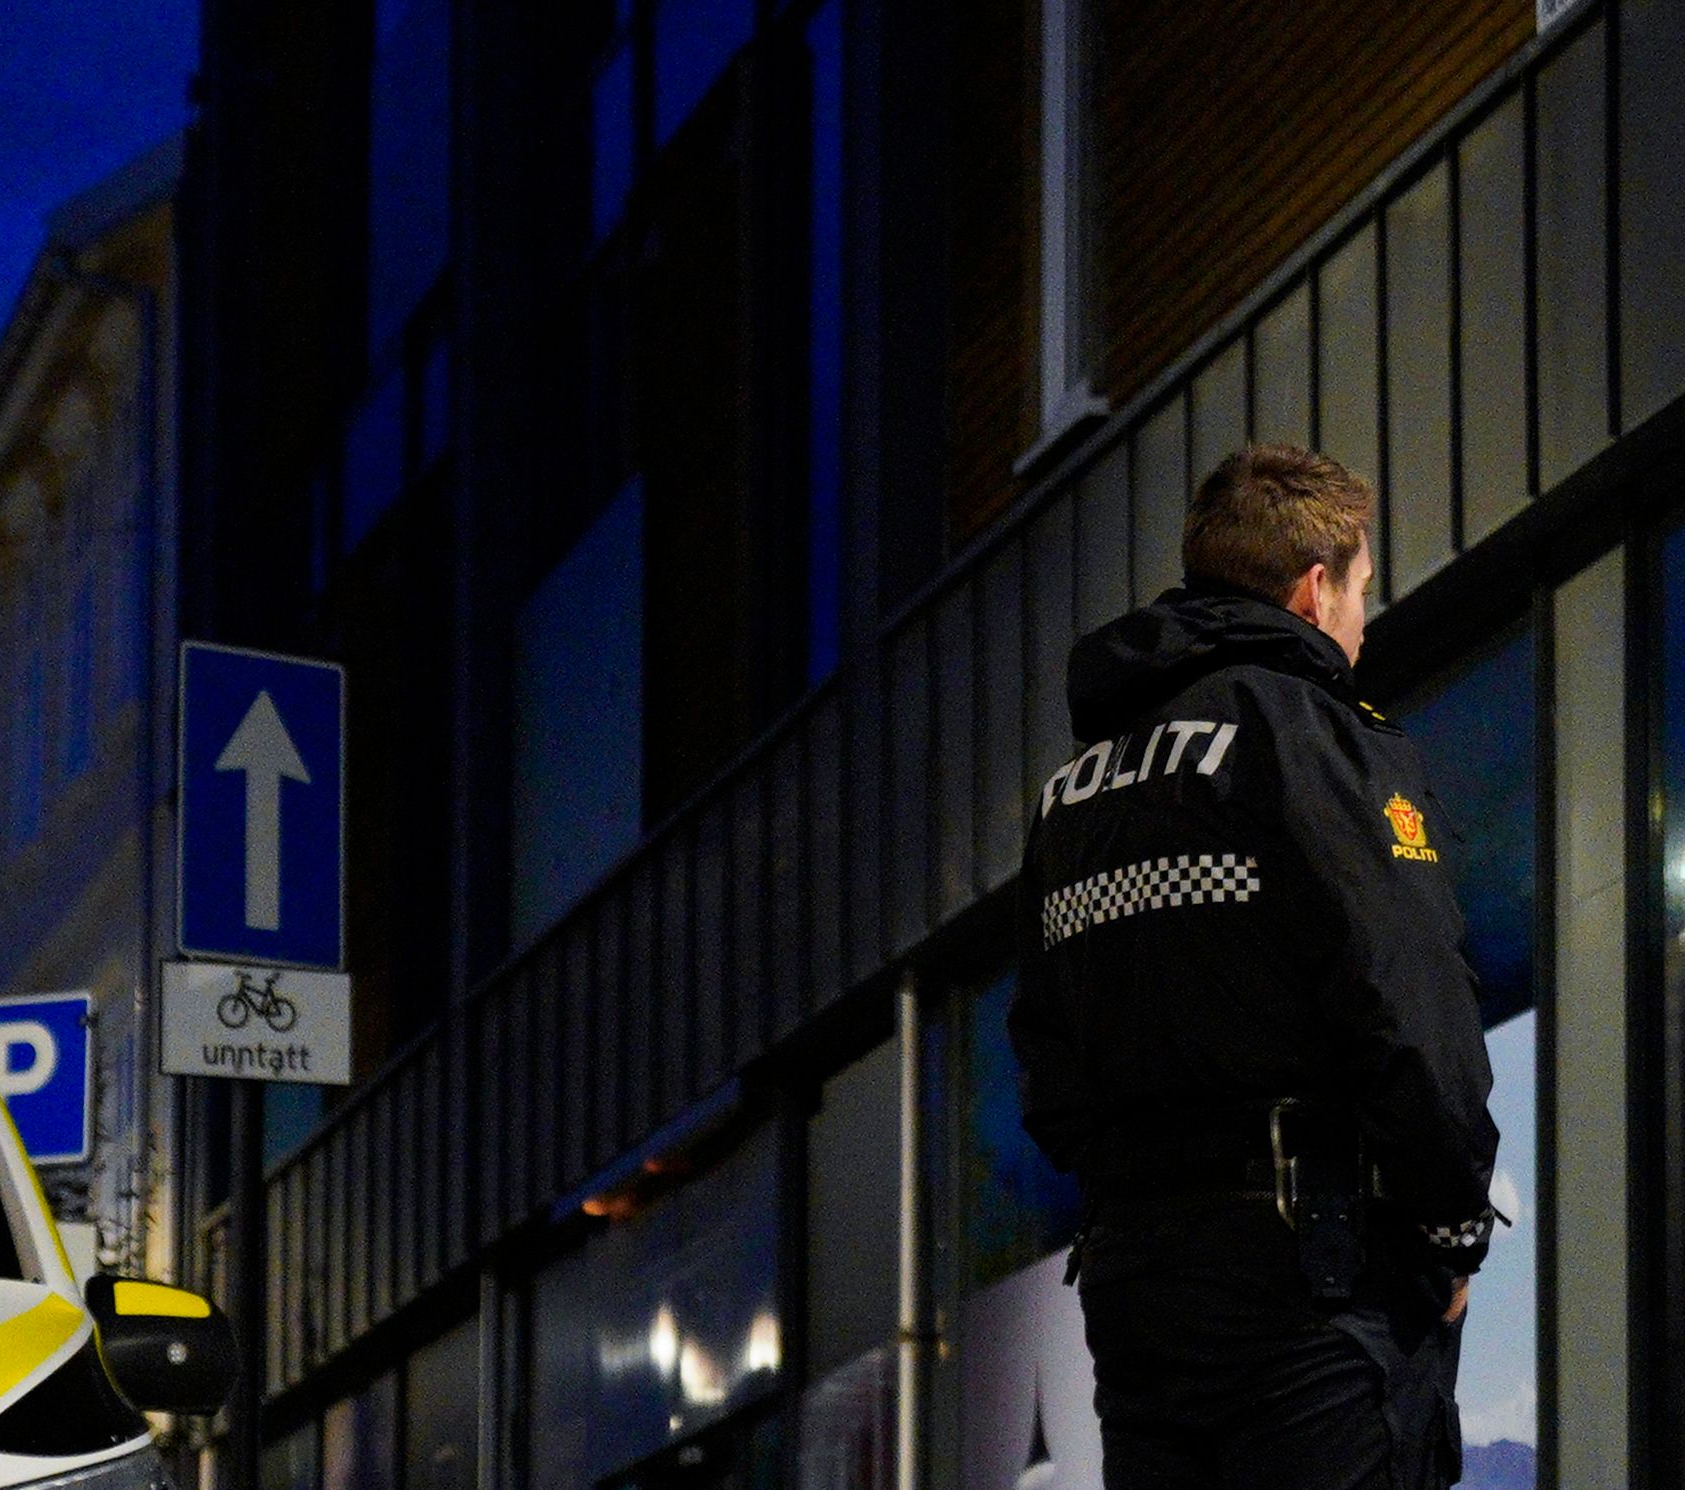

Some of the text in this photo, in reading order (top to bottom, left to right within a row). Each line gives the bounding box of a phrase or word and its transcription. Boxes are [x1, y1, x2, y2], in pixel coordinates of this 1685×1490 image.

[1042, 720, 1239, 820] POLITI
[1392, 844, 1439, 863] POLITI
[201, 1042, 312, 1071] unntatt
